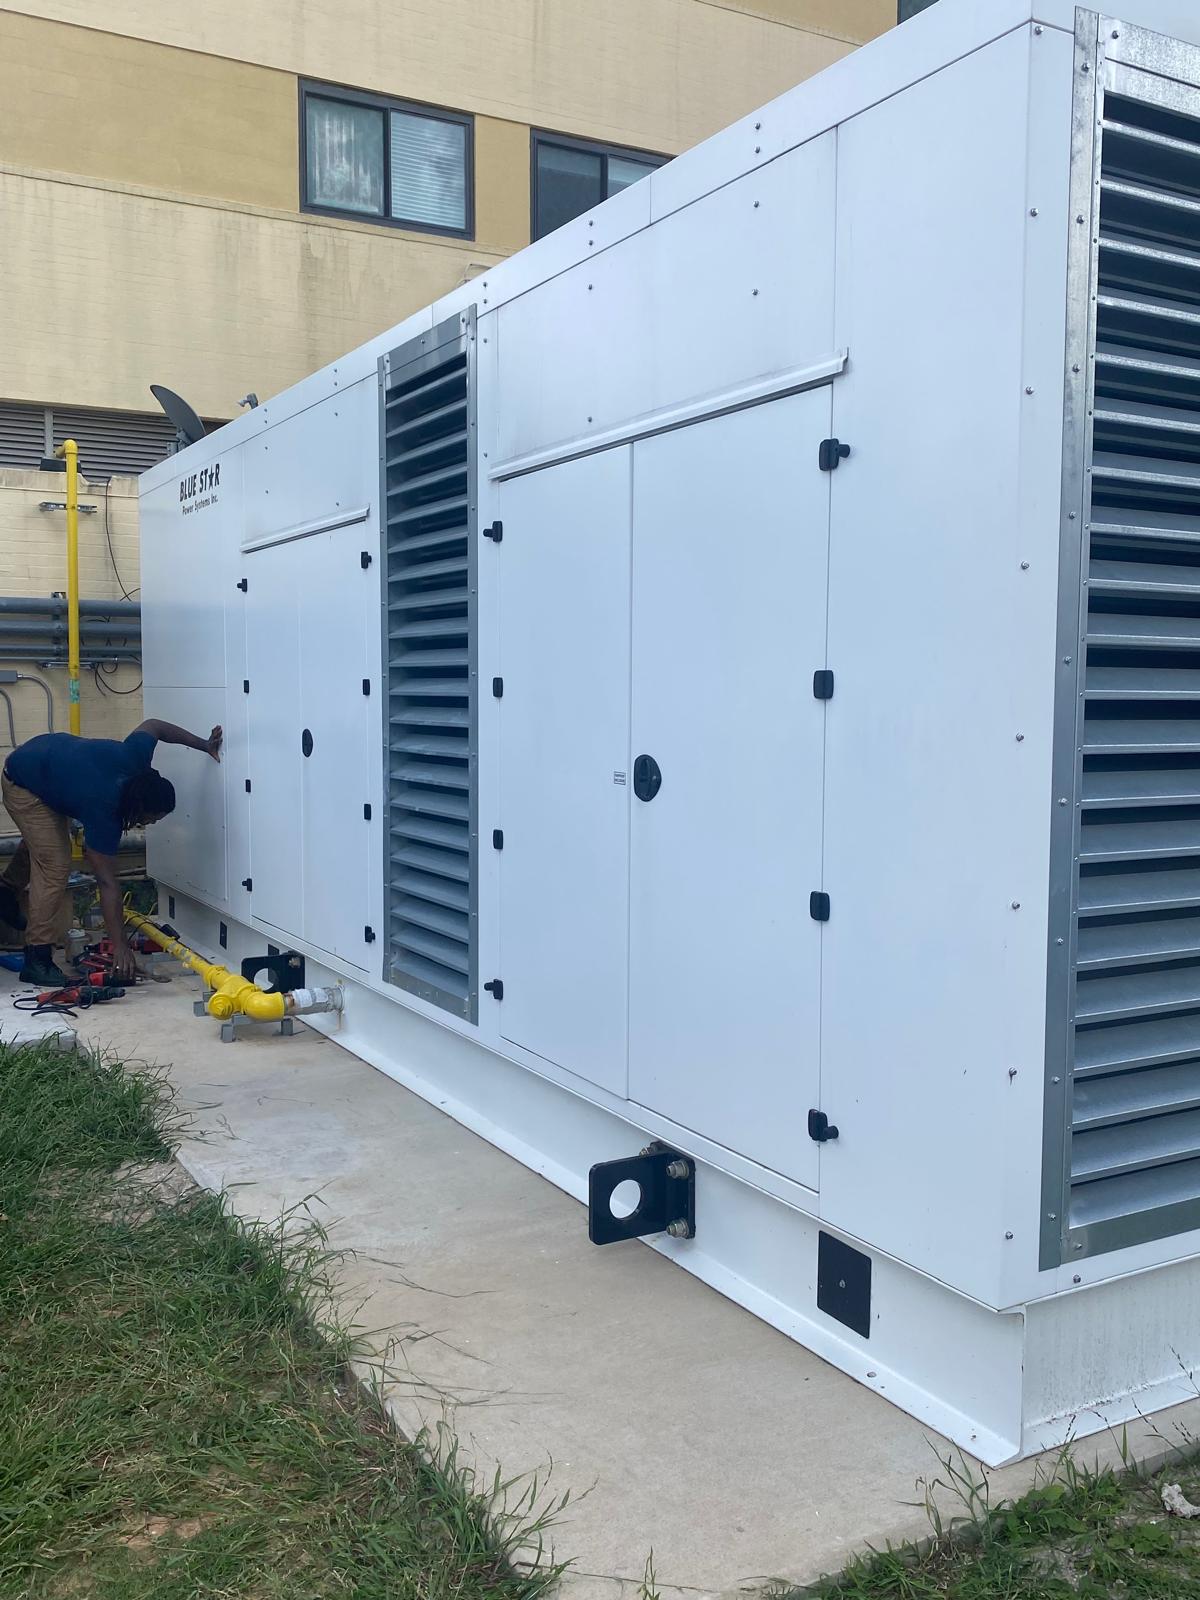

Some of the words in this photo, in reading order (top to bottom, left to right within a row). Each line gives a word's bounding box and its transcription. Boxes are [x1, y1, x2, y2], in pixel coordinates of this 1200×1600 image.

[180, 473, 197, 502] BLUE
[182, 505, 194, 515] Power
[194, 497, 211, 512] Systems
